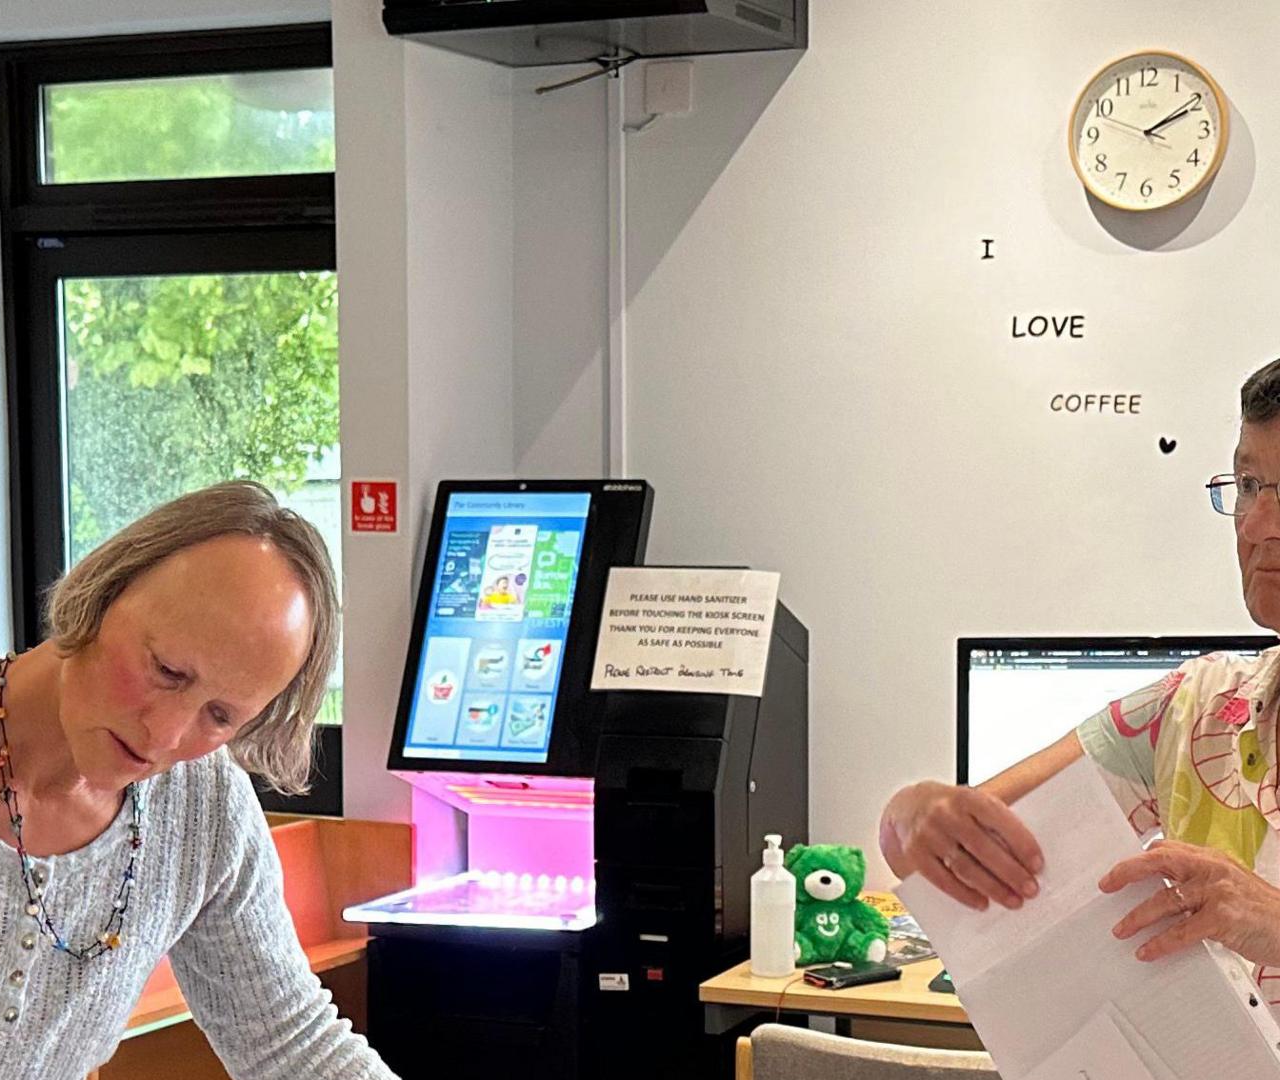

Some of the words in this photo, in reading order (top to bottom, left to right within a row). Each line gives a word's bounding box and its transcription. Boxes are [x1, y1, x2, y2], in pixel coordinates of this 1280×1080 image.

[1140, 68, 1158, 87] 12
[1174, 74, 1180, 92] 1
[1116, 78, 1130, 96] 11
[1096, 98, 1113, 118] 10
[1190, 92, 1202, 112] 2
[1087, 126, 1100, 144] 9
[1198, 120, 1210, 139] 3
[1095, 154, 1108, 172] 8
[1186, 148, 1200, 167] 4
[1116, 172, 1127, 190] 7
[1140, 178, 1153, 197] 6
[1168, 170, 1180, 188] 5
[981, 239, 994, 260] I
[1012, 316, 1084, 338] LOVE
[1050, 394, 1142, 414] COFFEE
[630, 594, 658, 602] PLEASE
[660, 594, 676, 602] USE
[678, 594, 704, 603] HAND
[704, 595, 748, 604] SANITIZER
[609, 609, 640, 617] BEFORE
[642, 610, 684, 618] TOUCHING
[687, 610, 703, 618] THE
[705, 611, 730, 620] KIOSK
[731, 612, 765, 622] SCREEN
[609, 625, 637, 633] THANK
[658, 626, 675, 634] FOR
[676, 626, 712, 635] KEEPING
[714, 628, 759, 637] EVERYONE
[638, 638, 648, 646] AS
[650, 639, 670, 647] SAFE
[672, 640, 683, 648] AS
[684, 640, 722, 649] POSSIBLE
